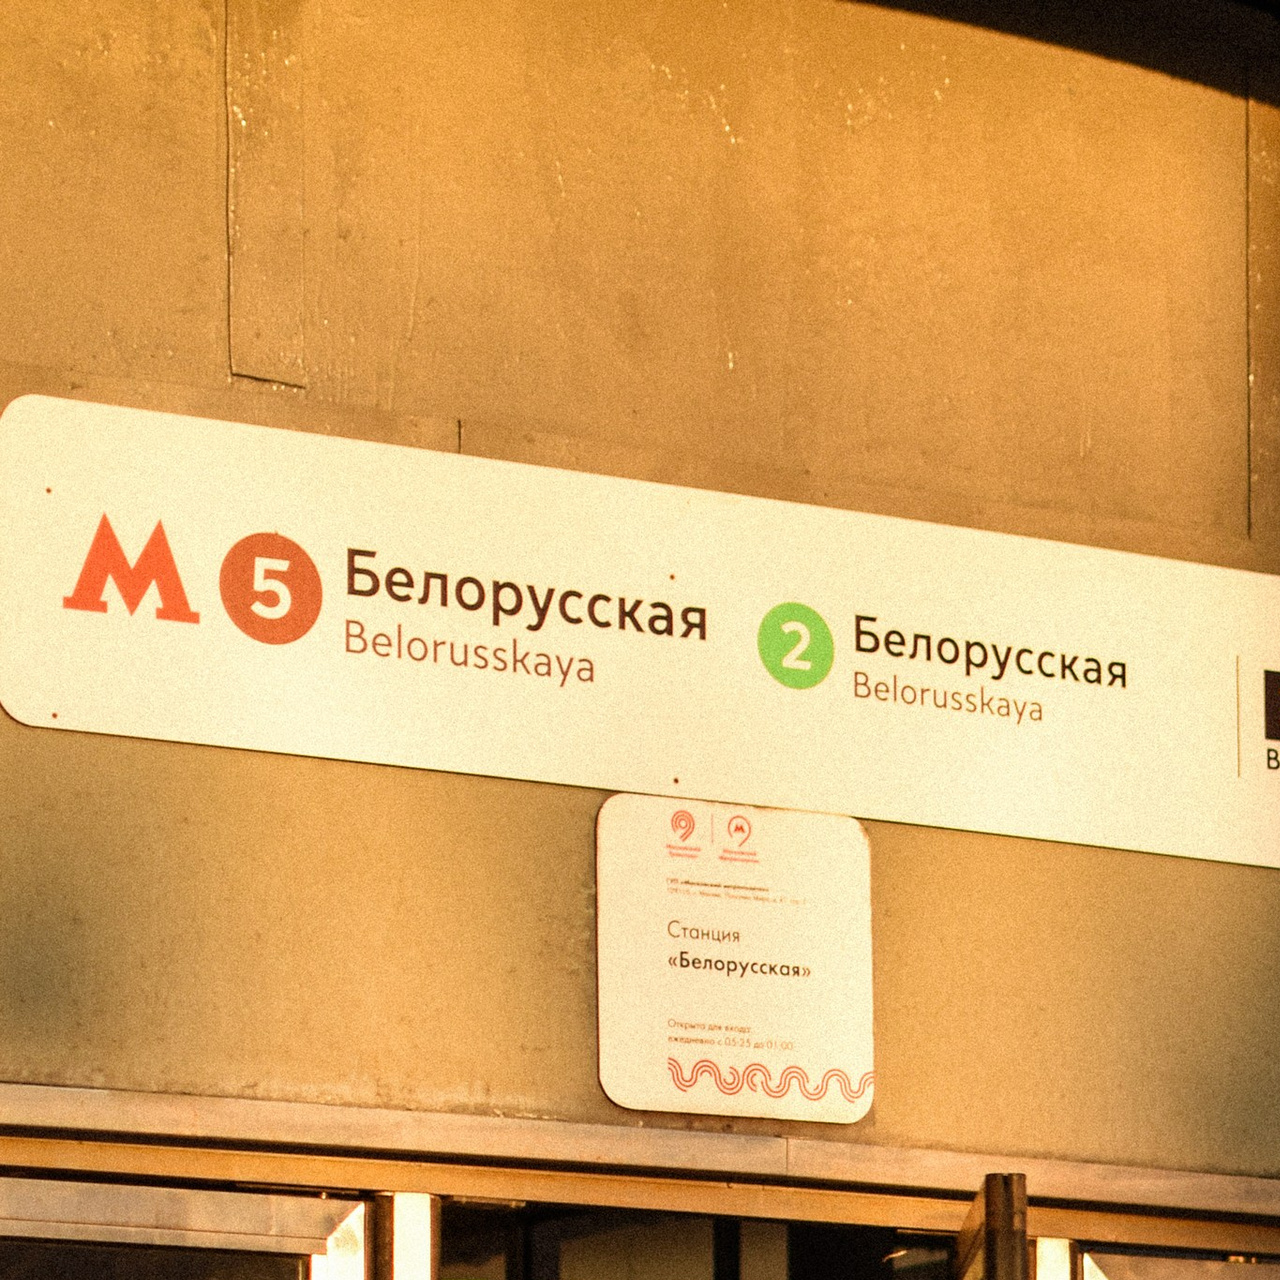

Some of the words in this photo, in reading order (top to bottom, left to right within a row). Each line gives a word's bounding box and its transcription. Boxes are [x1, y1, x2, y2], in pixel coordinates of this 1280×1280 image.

[250, 557, 292, 620] 5
[345, 548, 709, 640] Белорусская
[344, 620, 596, 687] Belorusskaya
[780, 621, 811, 671] 2
[854, 614, 1127, 689] Белорусская
[853, 672, 1044, 725] Belorusskaya
[667, 920, 741, 944] Станция
[668, 951, 812, 978] «Белорусская»
